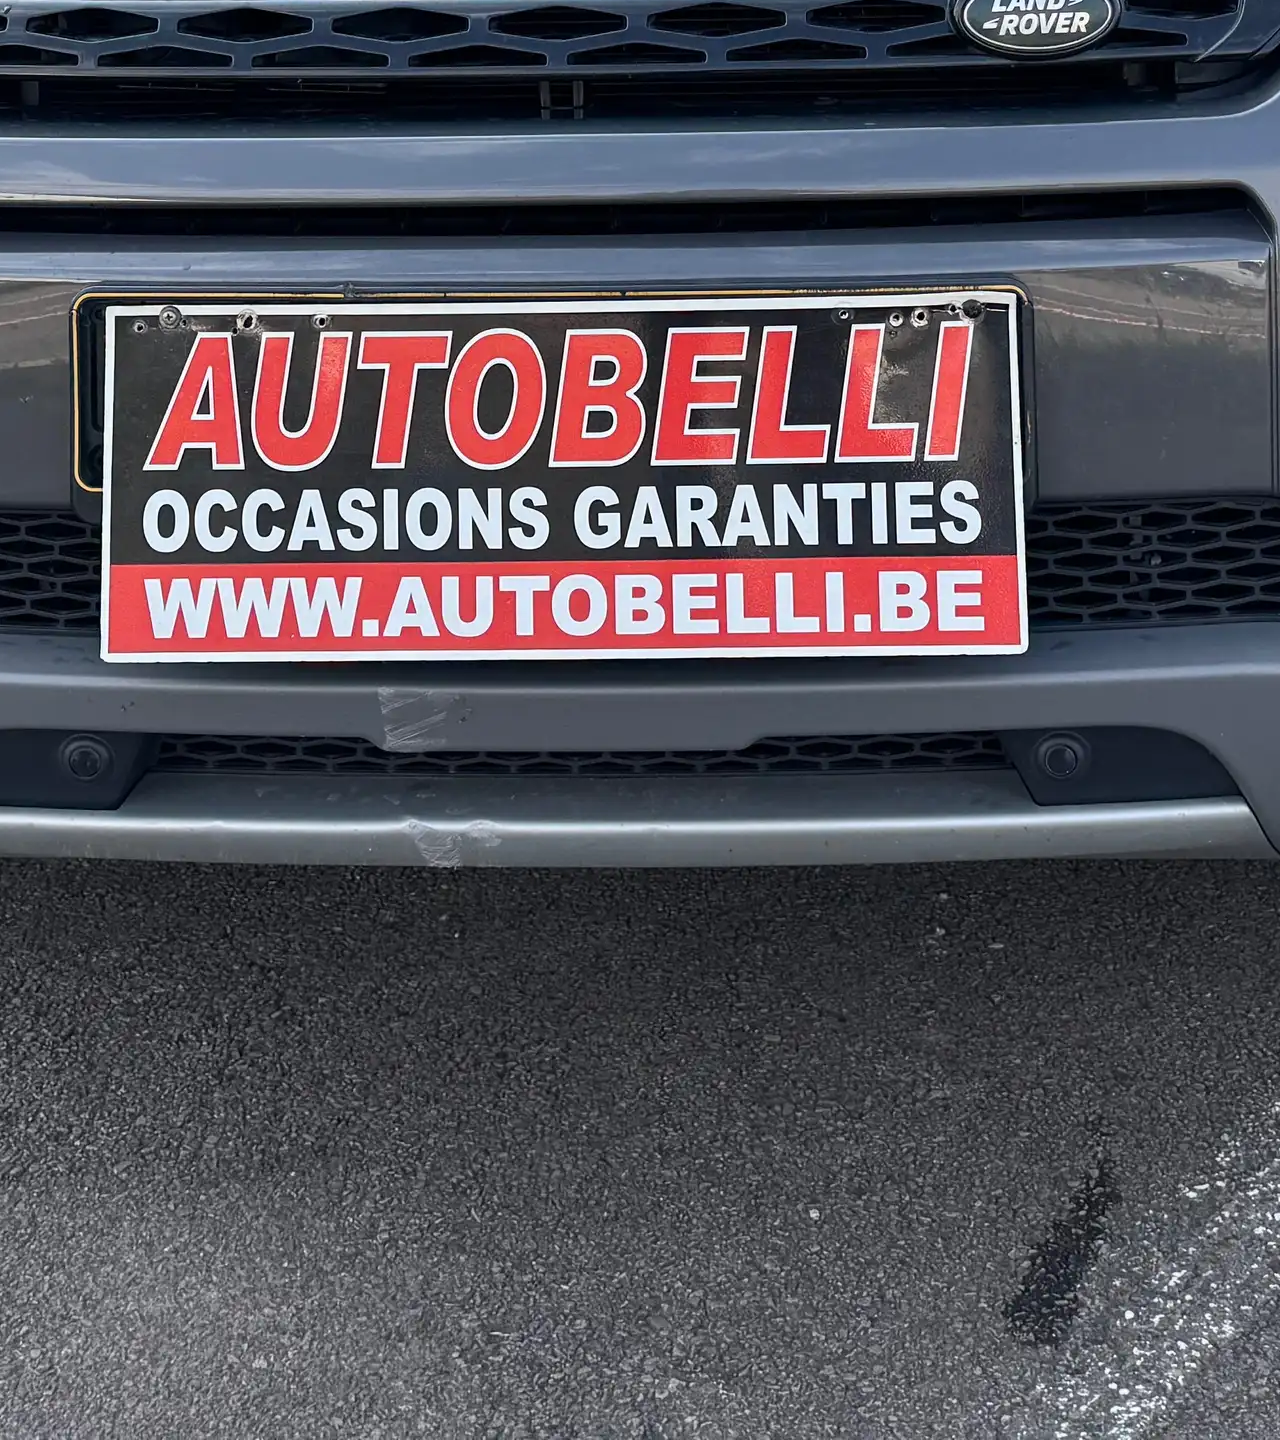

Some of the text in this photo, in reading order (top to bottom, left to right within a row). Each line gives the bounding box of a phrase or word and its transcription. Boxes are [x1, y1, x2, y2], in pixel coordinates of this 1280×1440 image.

[999, 12, 1090, 36] ROVER
[143, 325, 973, 471] AUTOBELLI
[142, 479, 982, 553] OCCASIONS GARANTIES
[144, 570, 986, 639] WWW.AUTOBELLI.BE
